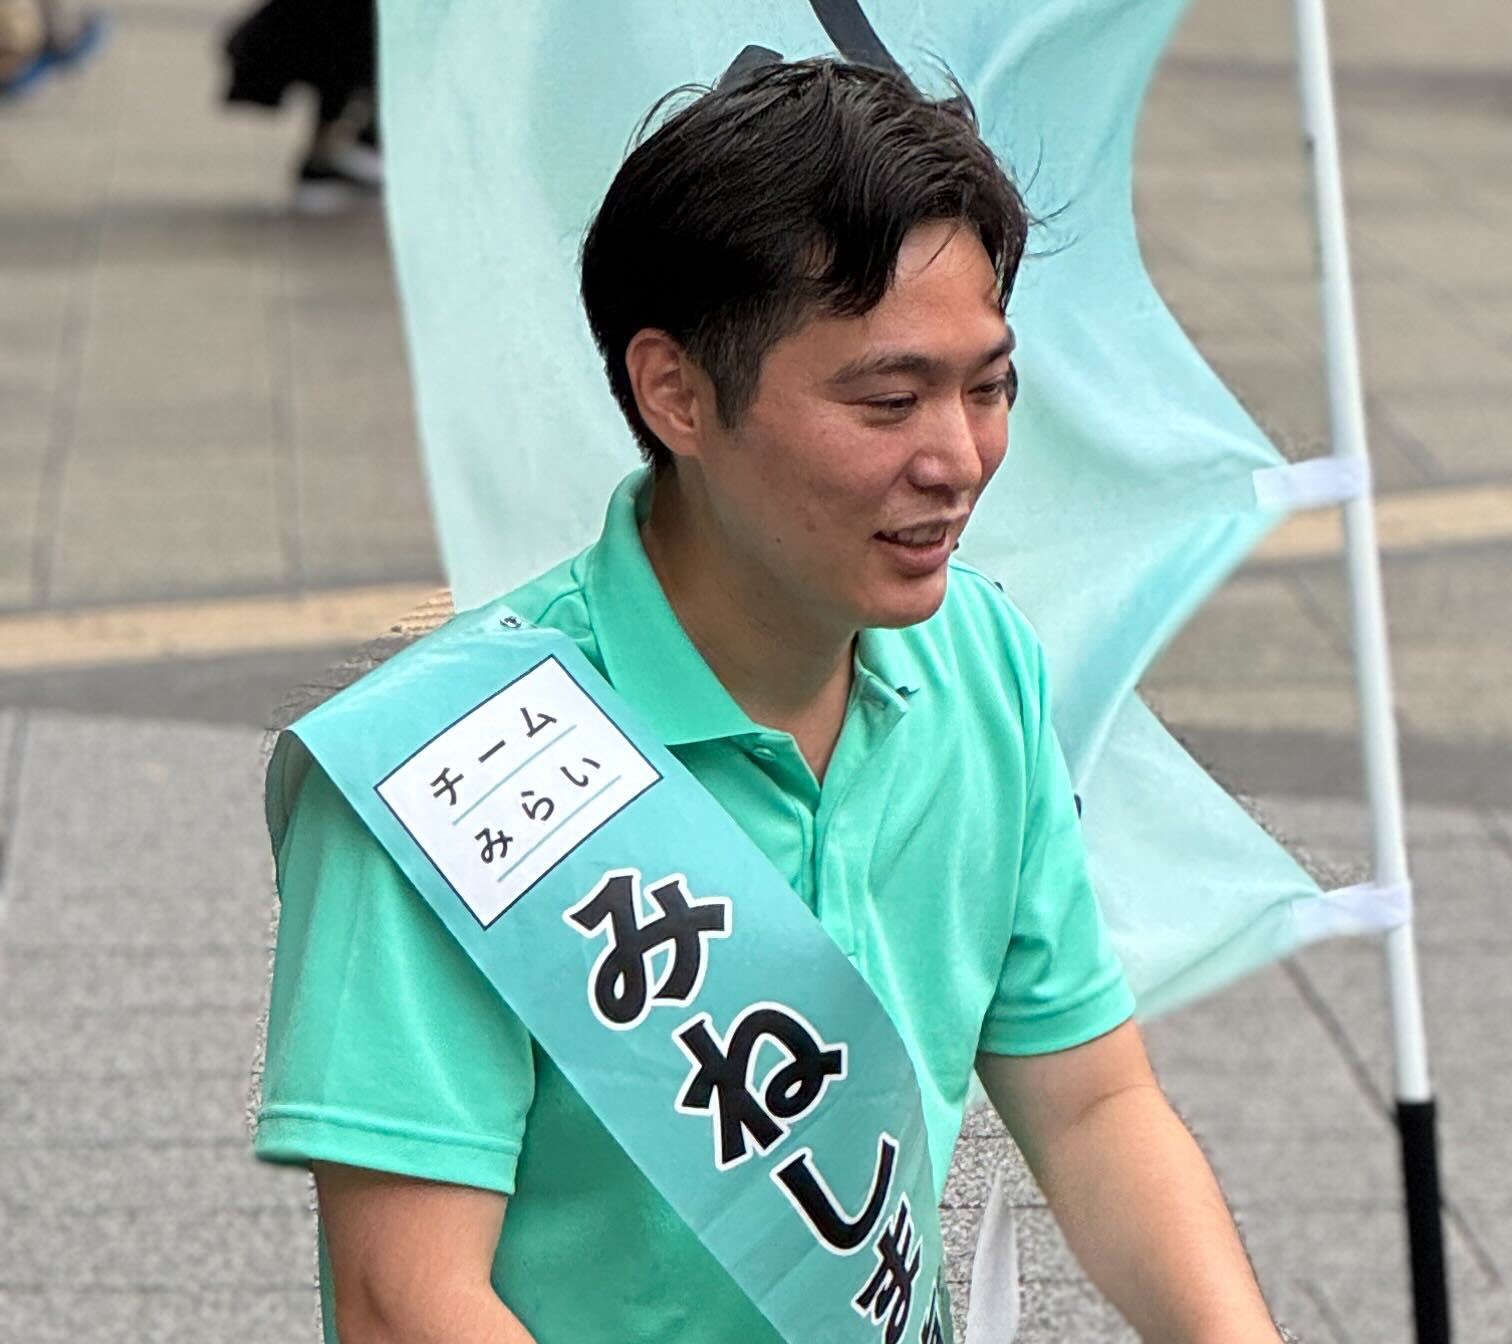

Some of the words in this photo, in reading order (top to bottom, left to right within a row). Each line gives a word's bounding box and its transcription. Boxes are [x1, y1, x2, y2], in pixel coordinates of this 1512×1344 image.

[429, 704, 558, 807] チーム
[473, 754, 601, 866] みらい
